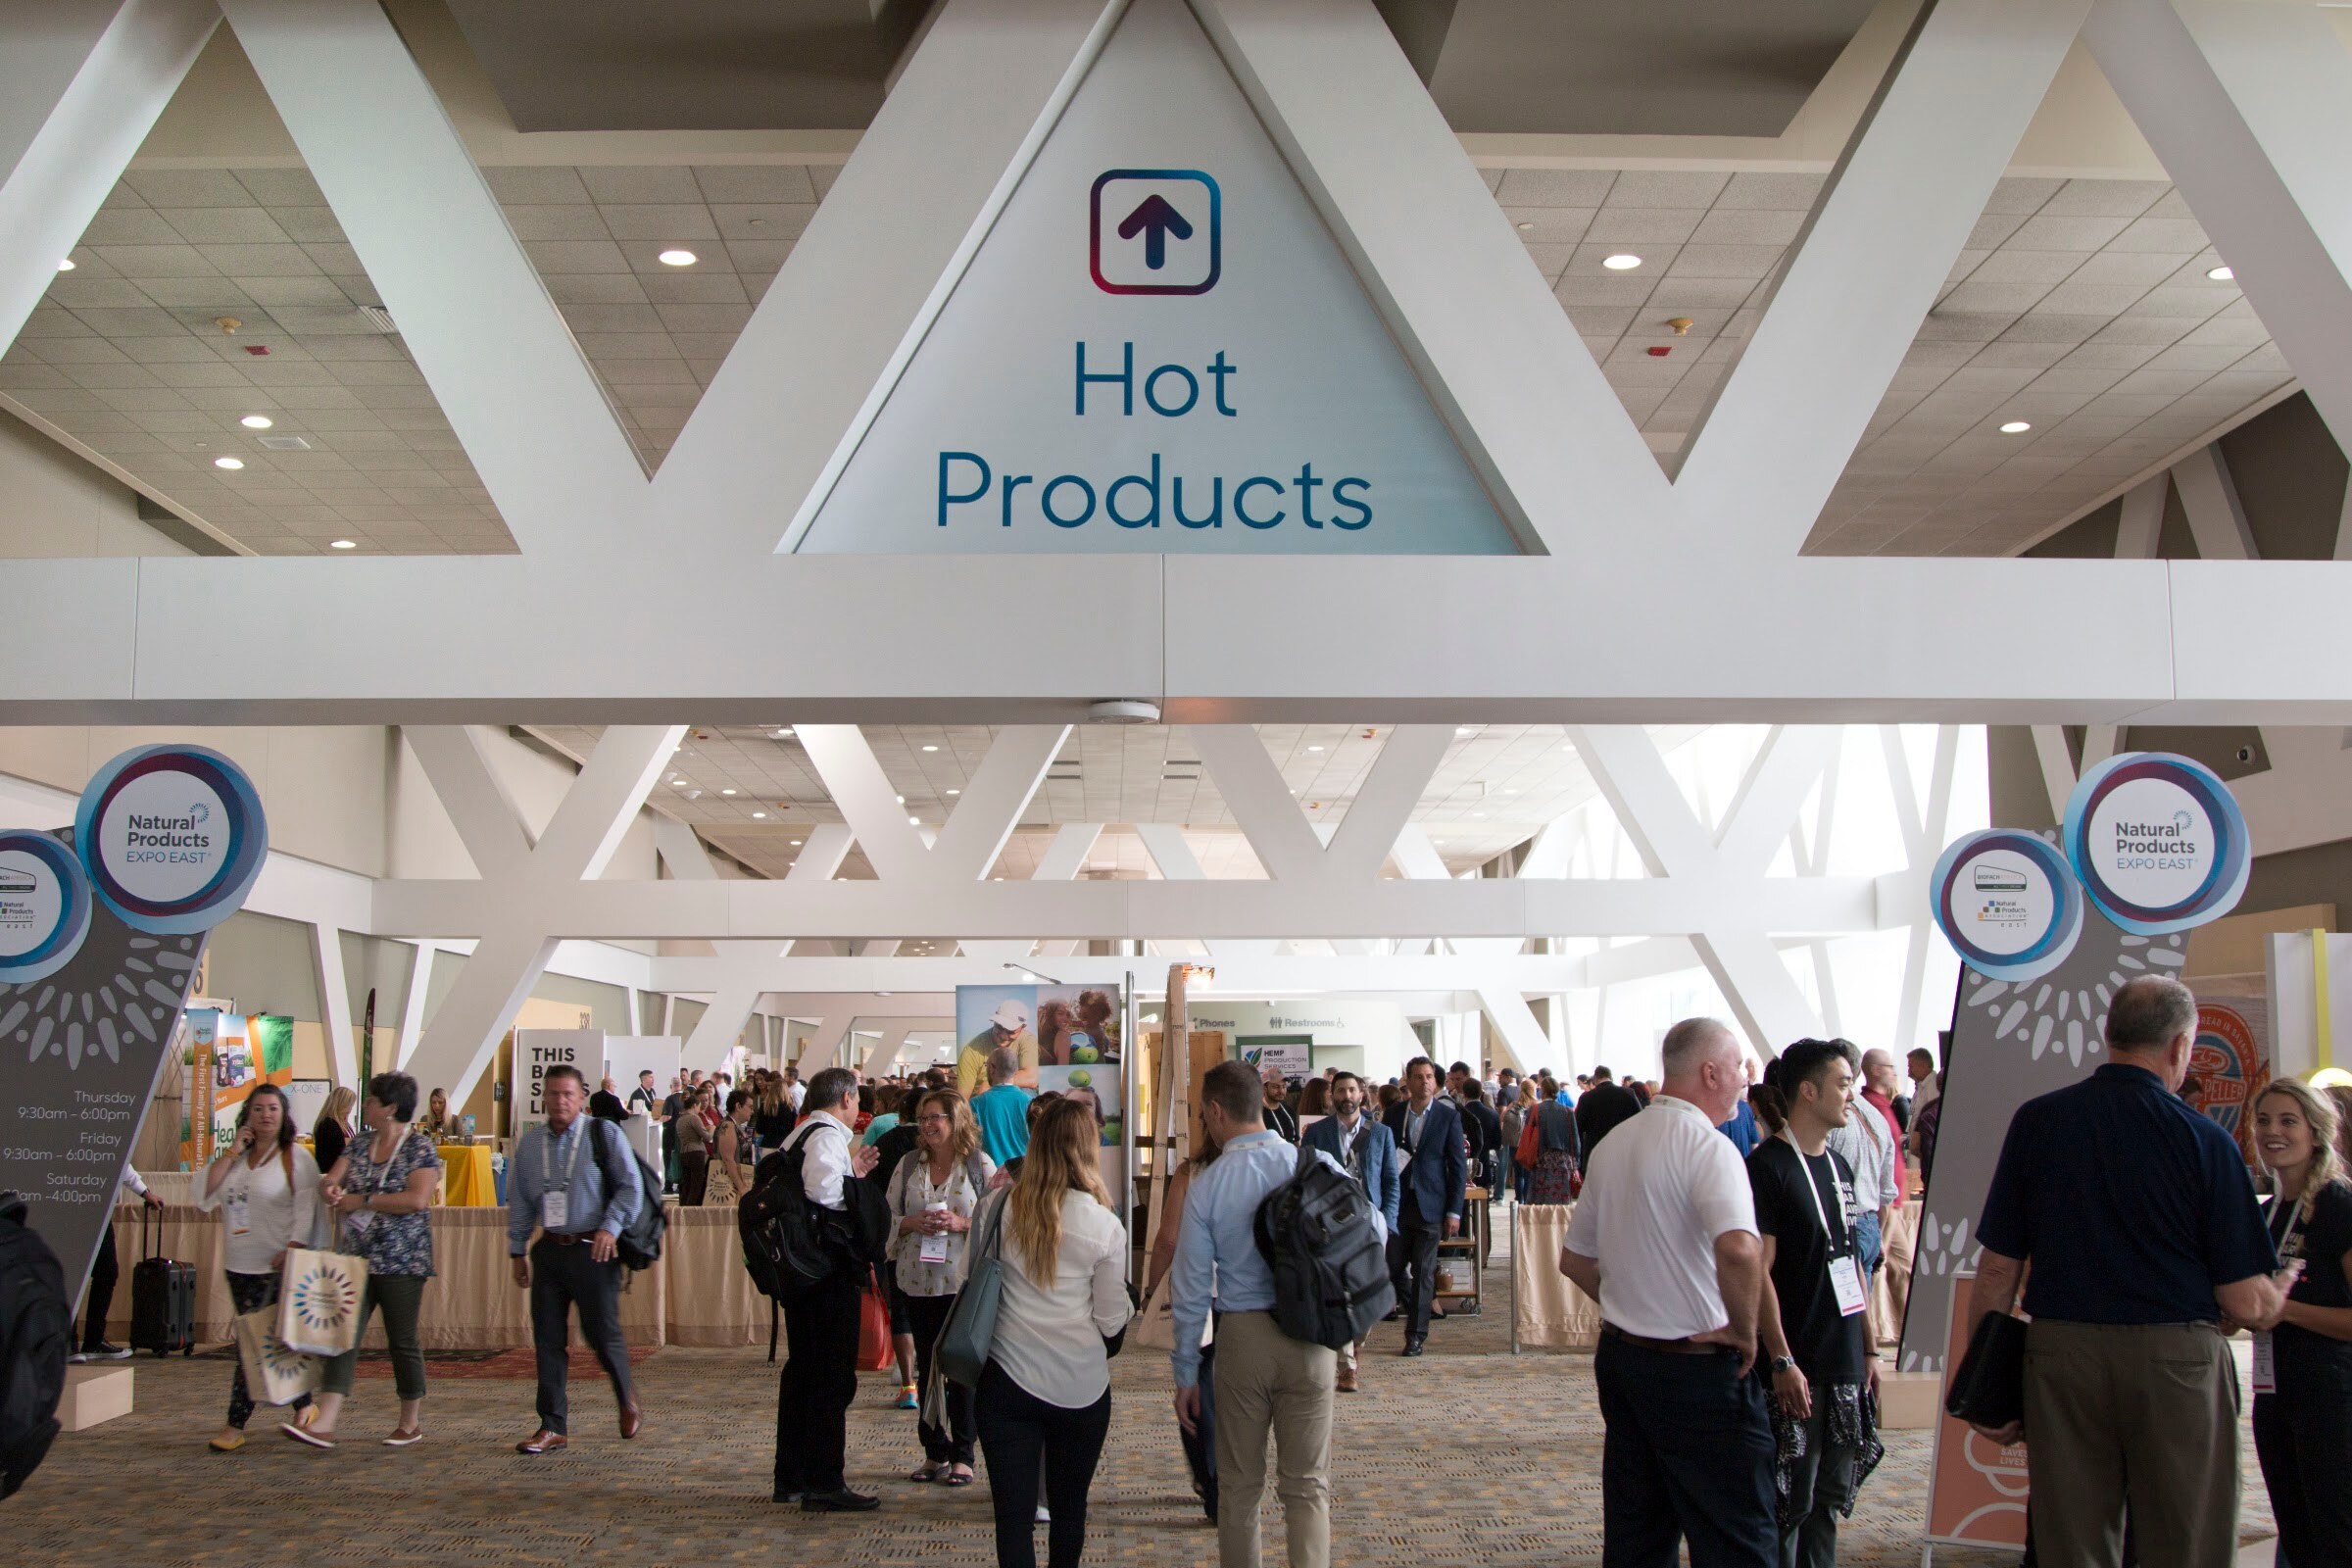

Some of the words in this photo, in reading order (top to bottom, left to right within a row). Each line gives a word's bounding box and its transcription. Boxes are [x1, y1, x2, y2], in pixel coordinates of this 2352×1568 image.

[1076, 341, 1237, 417] Hot
[938, 451, 1373, 531] Products
[128, 814, 196, 830] Natural
[2116, 822, 2180, 837] Natural
[127, 831, 210, 848] Products
[2117, 839, 2196, 854] Products
[126, 851, 167, 863] EXPO
[2117, 858, 2155, 869] EXPO
[1200, 1017, 1236, 1028] Phones
[1284, 1017, 1337, 1027] Restrooms
[199, 1054, 208, 1067] The
[531, 1048, 575, 1062] THIS
[74, 1090, 136, 1106] Thursday
[196, 1086, 206, 1110] Family
[2204, 1078, 2244, 1102] PELLER
[18, 1106, 68, 1119] 9:30am
[80, 1107, 130, 1123] 6:00pm
[80, 1132, 122, 1148] Friday
[3, 1148, 53, 1160] 9:30am
[66, 1149, 116, 1164] 6:00pm
[47, 1172, 108, 1189] Saturday
